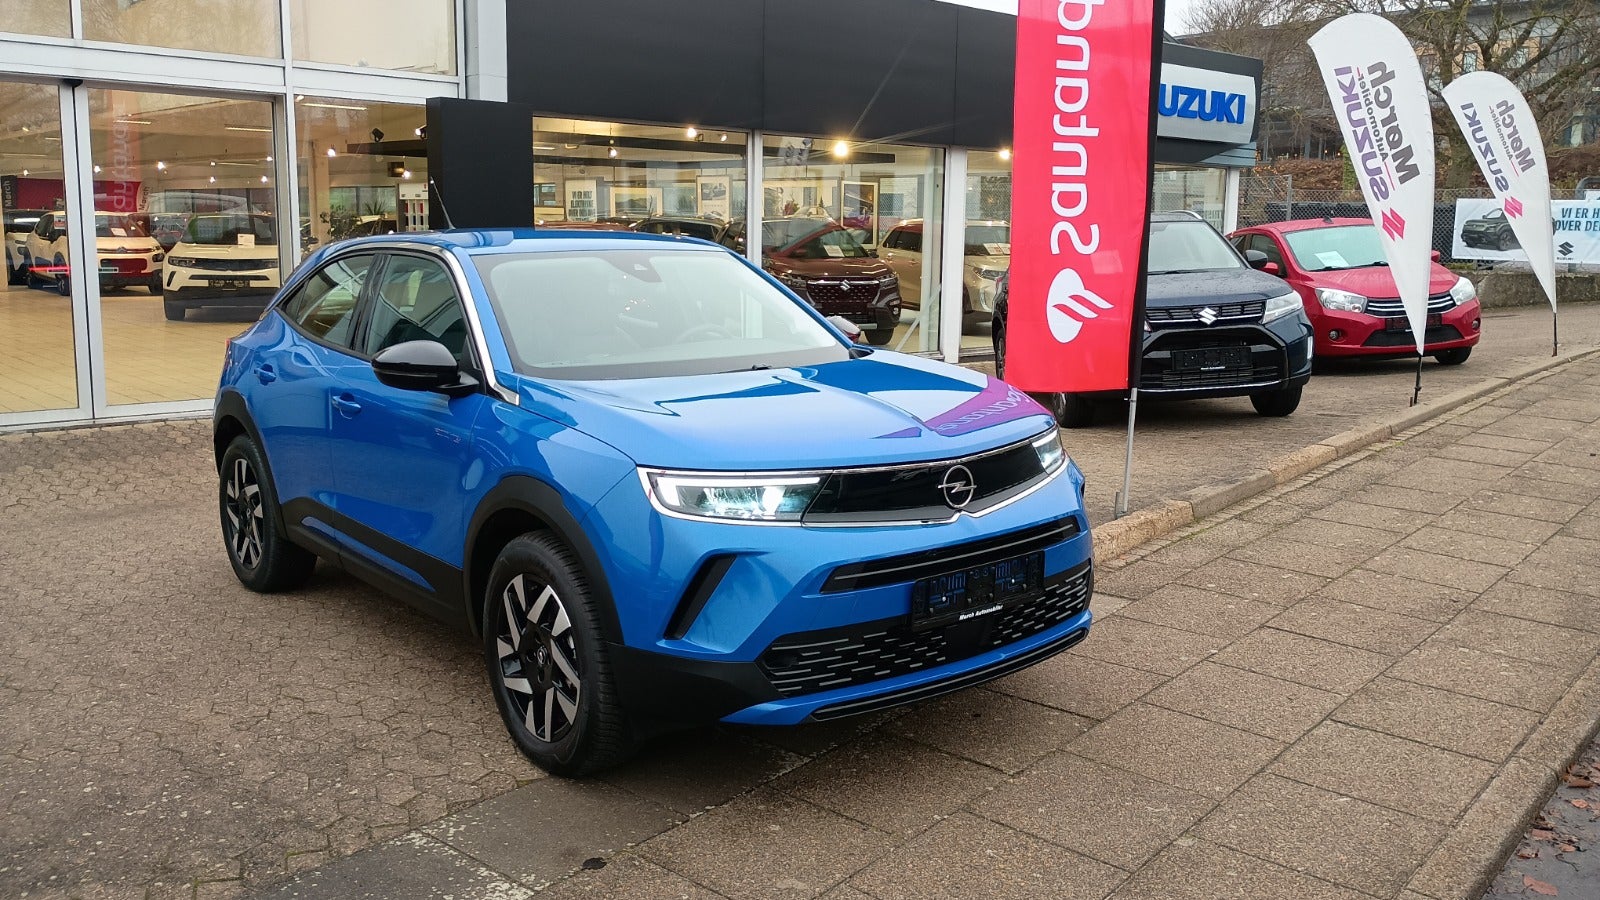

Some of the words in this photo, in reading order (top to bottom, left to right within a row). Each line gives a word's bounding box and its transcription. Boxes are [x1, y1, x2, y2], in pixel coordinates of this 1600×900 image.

[1158, 83, 1246, 125] UZUKI
[1561, 207, 1573, 219] VI
[1574, 207, 1589, 219] ER
[1555, 220, 1582, 231] OVER
[1584, 220, 1600, 231] DE
